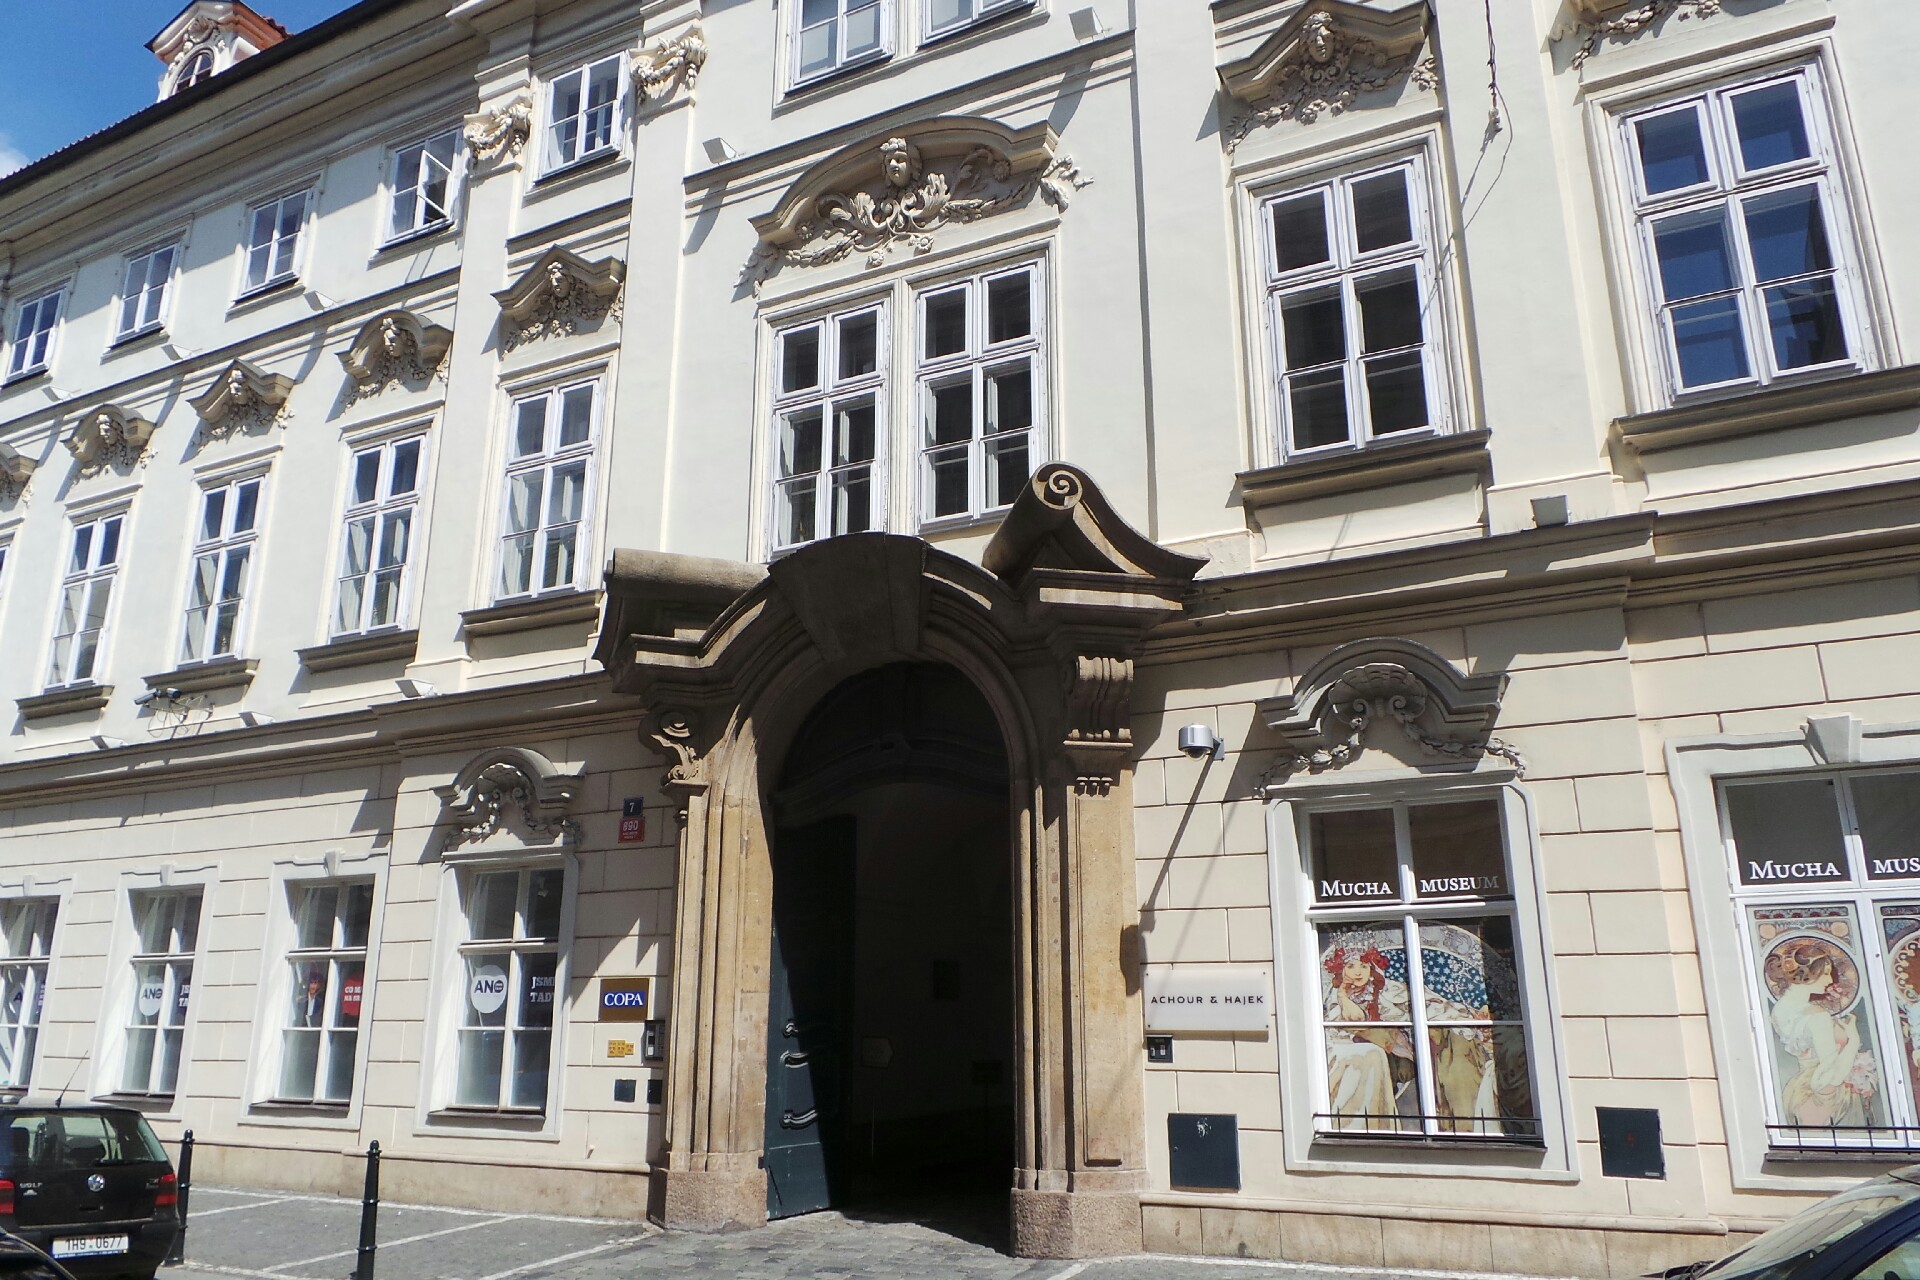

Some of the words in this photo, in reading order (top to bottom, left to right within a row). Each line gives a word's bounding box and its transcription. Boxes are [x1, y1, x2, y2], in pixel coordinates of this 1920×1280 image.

[629, 802, 635, 813] 7
[623, 820, 639, 832] 890
[1748, 859, 1842, 880] MUCHA
[1320, 878, 1393, 897] MUCHA
[1420, 875, 1500, 893] MUSEUM
[474, 979, 504, 994] ANO
[531, 976, 555, 989] JSM
[529, 992, 554, 1003] TAD
[604, 992, 643, 1006] COPA
[1151, 995, 1203, 1004] ACHOUR
[1210, 995, 1218, 1004] &
[1224, 995, 1264, 1005] HAJEK
[65, 1238, 86, 1251] 1H9
[96, 1235, 123, 1249] 0677
